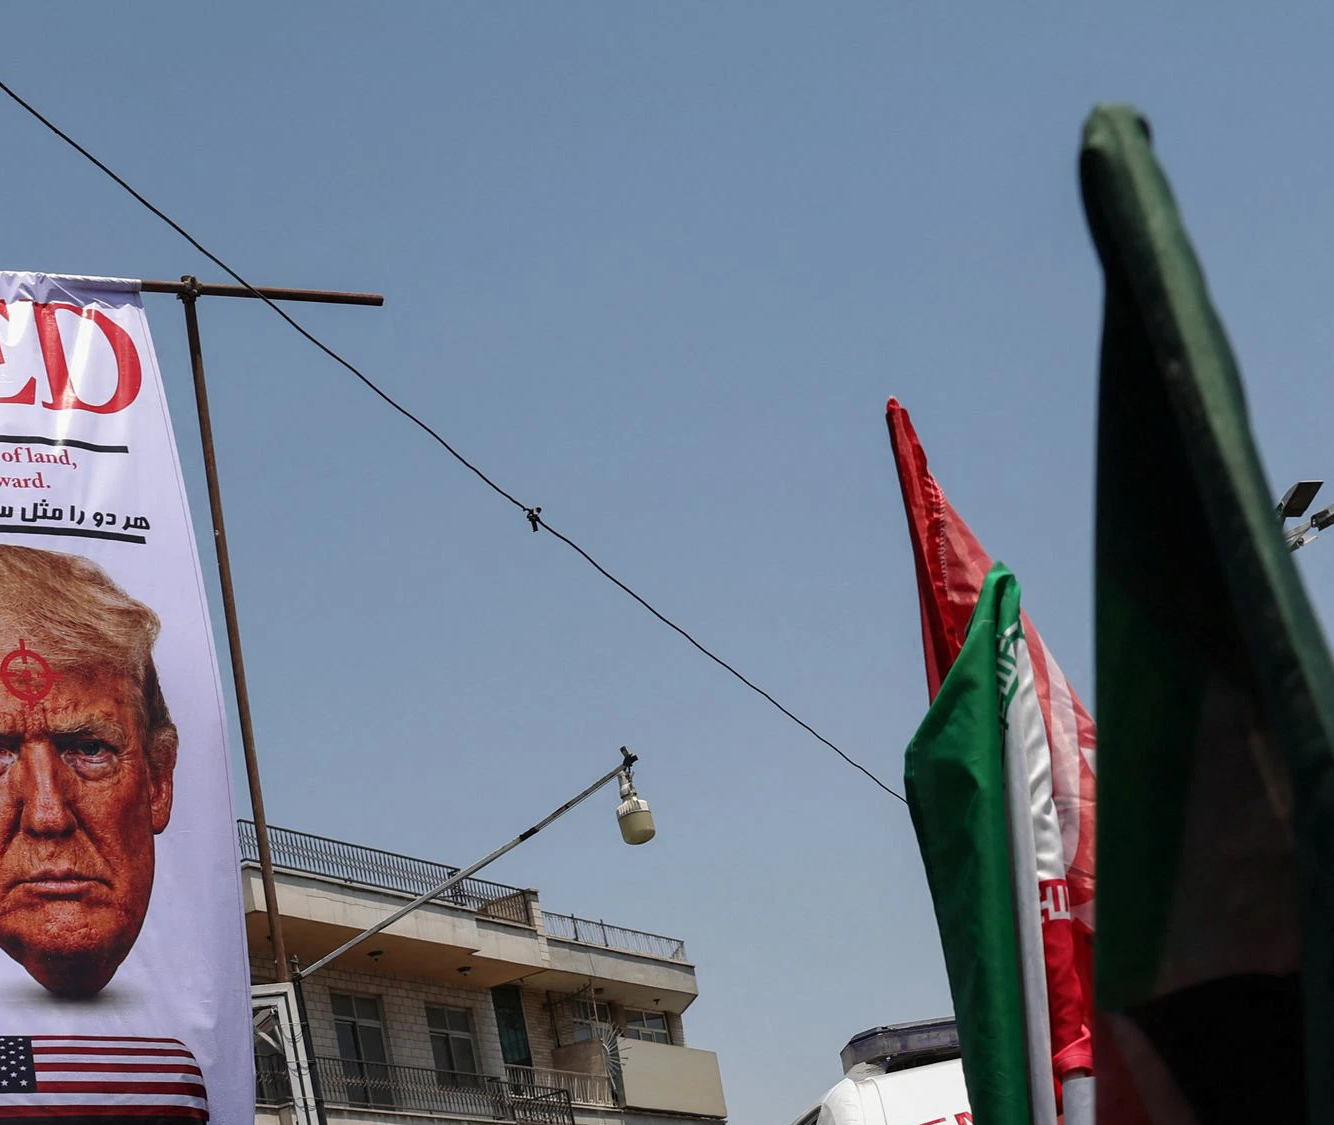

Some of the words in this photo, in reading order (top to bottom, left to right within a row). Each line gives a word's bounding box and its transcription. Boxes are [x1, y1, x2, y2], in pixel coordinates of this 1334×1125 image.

[1, 446, 23, 464] of
[26, 447, 79, 470] land,
[20, 499, 65, 523] مثل
[69, 503, 85, 526] را
[91, 508, 117, 527] دو
[121, 513, 152, 531] هر
